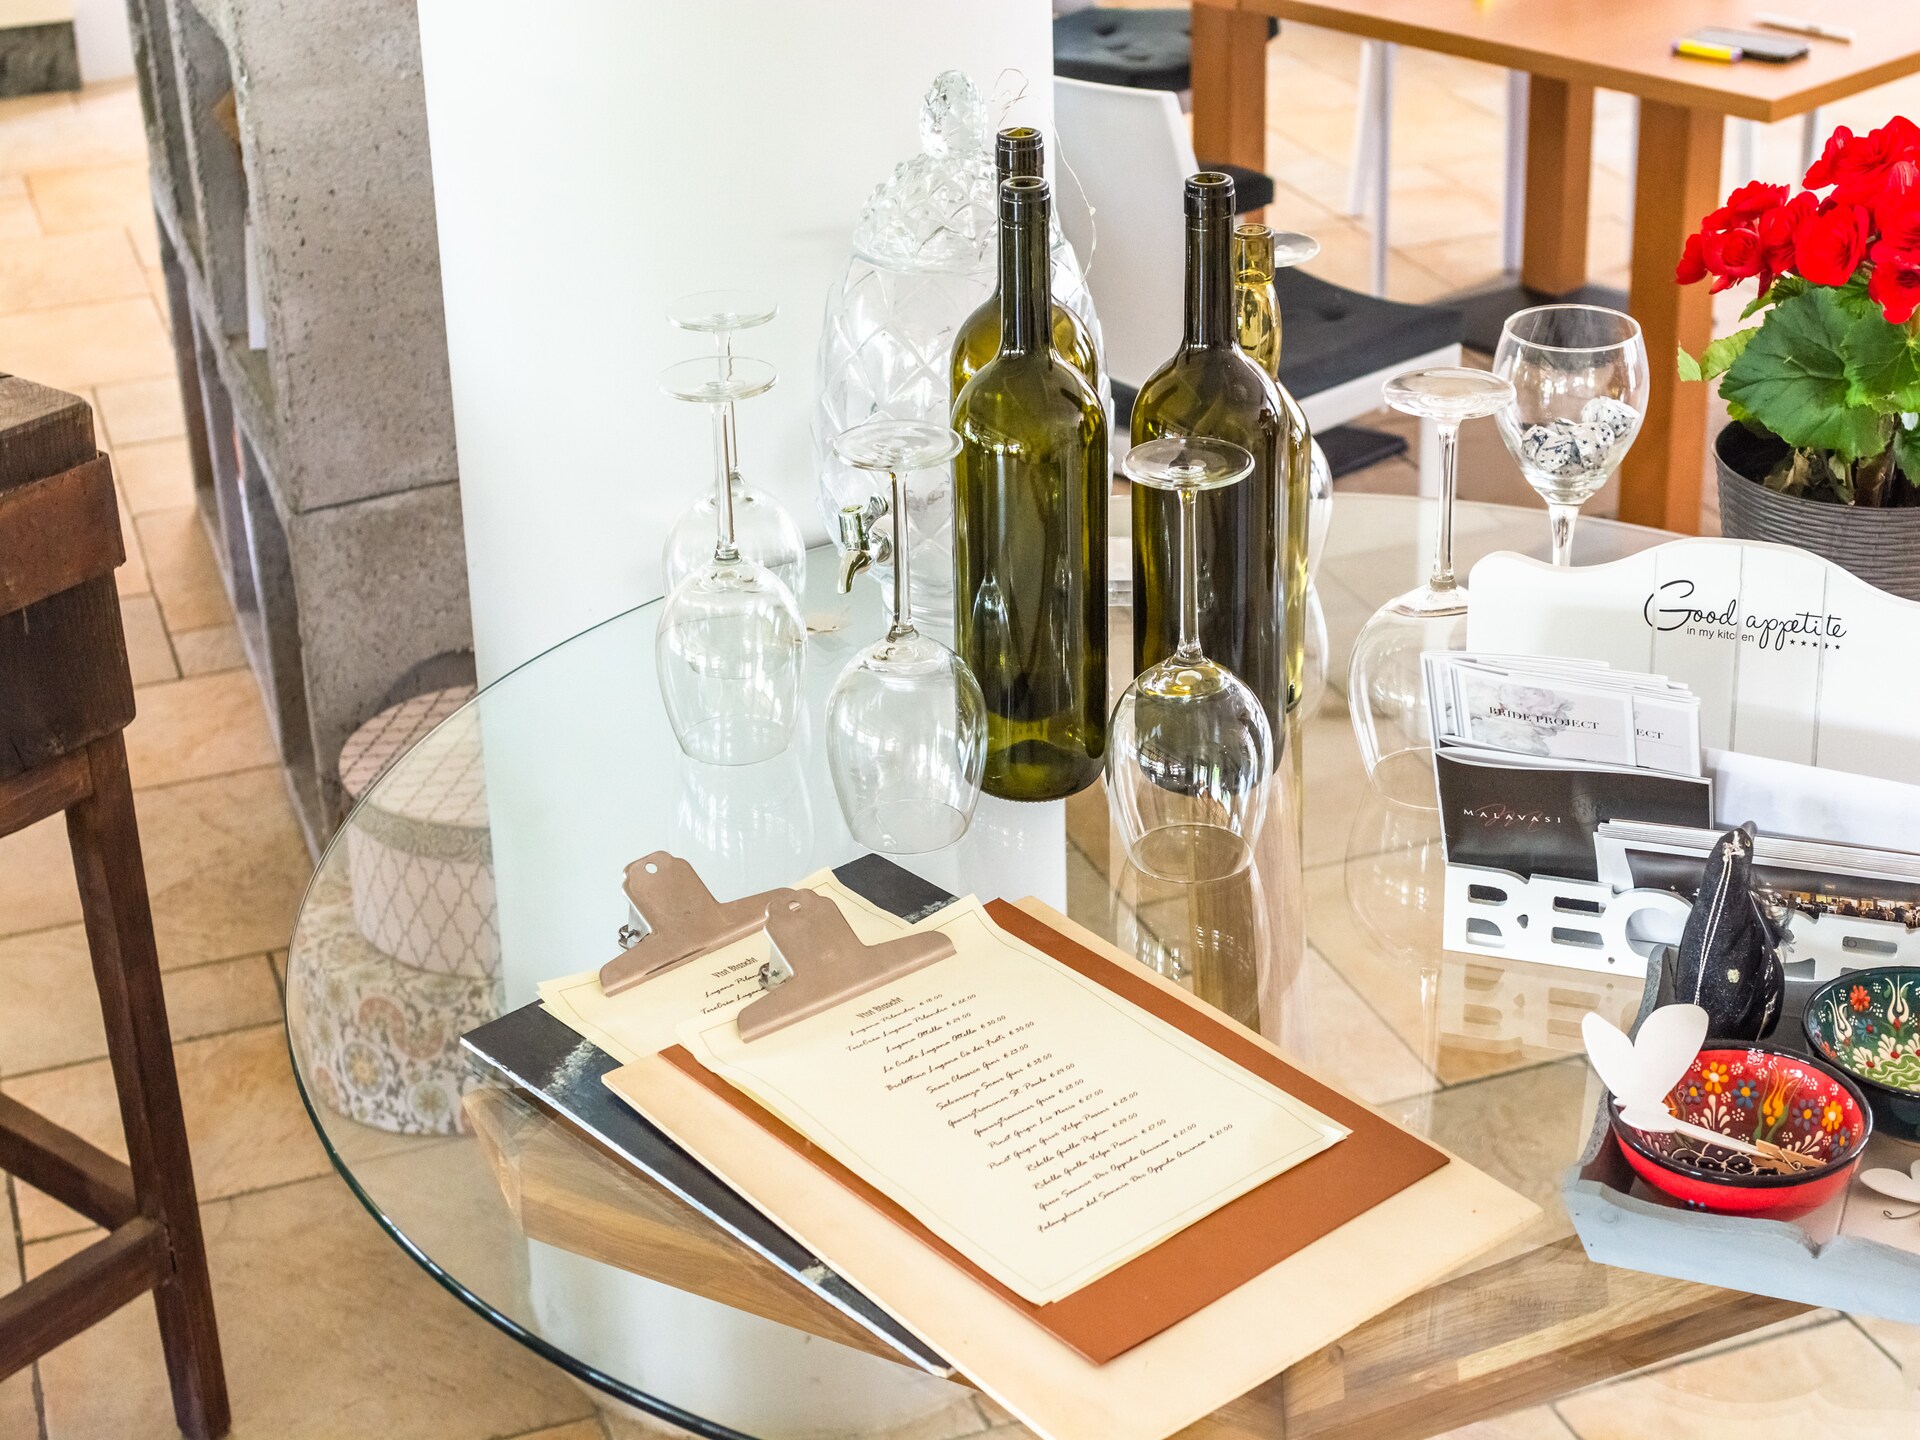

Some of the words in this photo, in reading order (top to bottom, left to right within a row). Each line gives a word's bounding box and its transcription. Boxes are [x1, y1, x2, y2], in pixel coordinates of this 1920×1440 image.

[1644, 580, 1737, 631] Good
[1746, 612, 1847, 651] appetite
[1687, 626, 1696, 635] in
[1698, 629, 1714, 639] my
[1717, 631, 1754, 642] kitcen
[1489, 706, 1532, 722] BRIDE
[1536, 715, 1600, 730] PROJECT
[1463, 808, 1562, 824] MALAVASI
[712, 967, 730, 979] Vini
[729, 956, 758, 973] Bianchi
[706, 984, 735, 998] Lugana
[856, 1006, 875, 1019] Vini
[873, 996, 903, 1013] Bianchi
